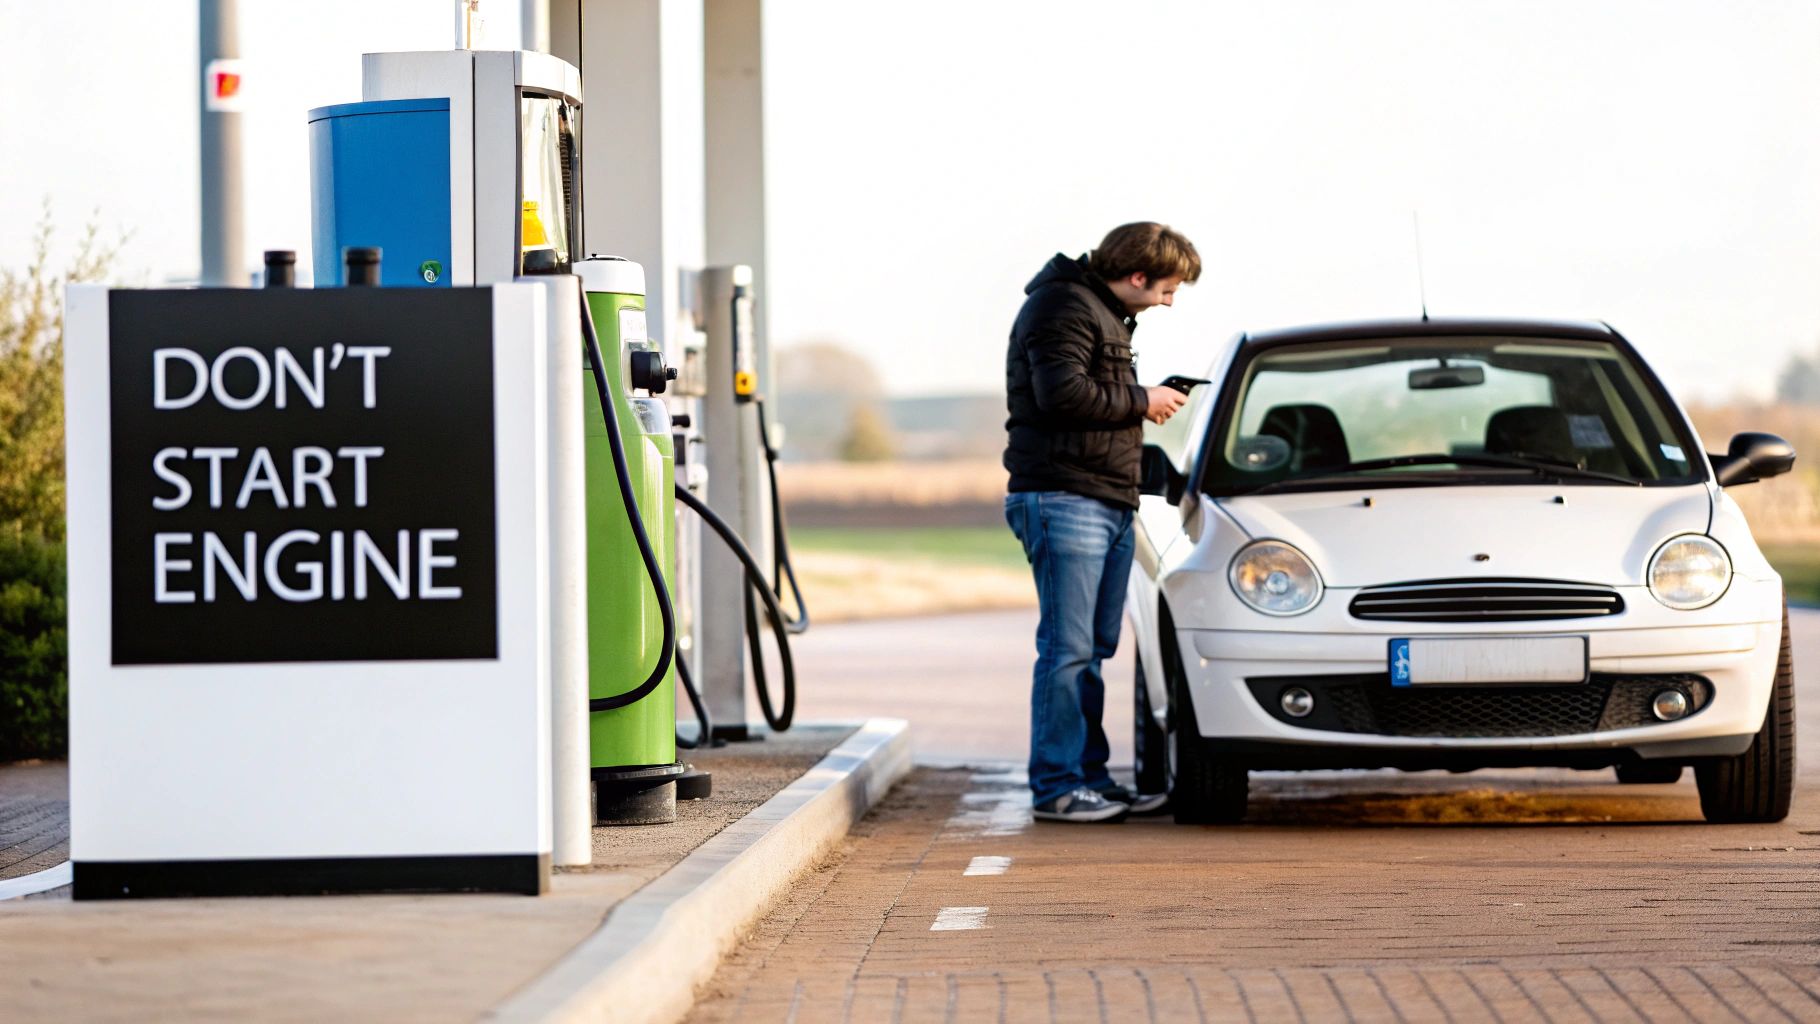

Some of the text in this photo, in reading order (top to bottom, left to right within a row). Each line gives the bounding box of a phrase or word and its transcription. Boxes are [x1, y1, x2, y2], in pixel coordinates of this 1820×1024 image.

[153, 342, 392, 410] DON’T
[152, 446, 385, 510] START
[154, 528, 462, 603] ENGINE
